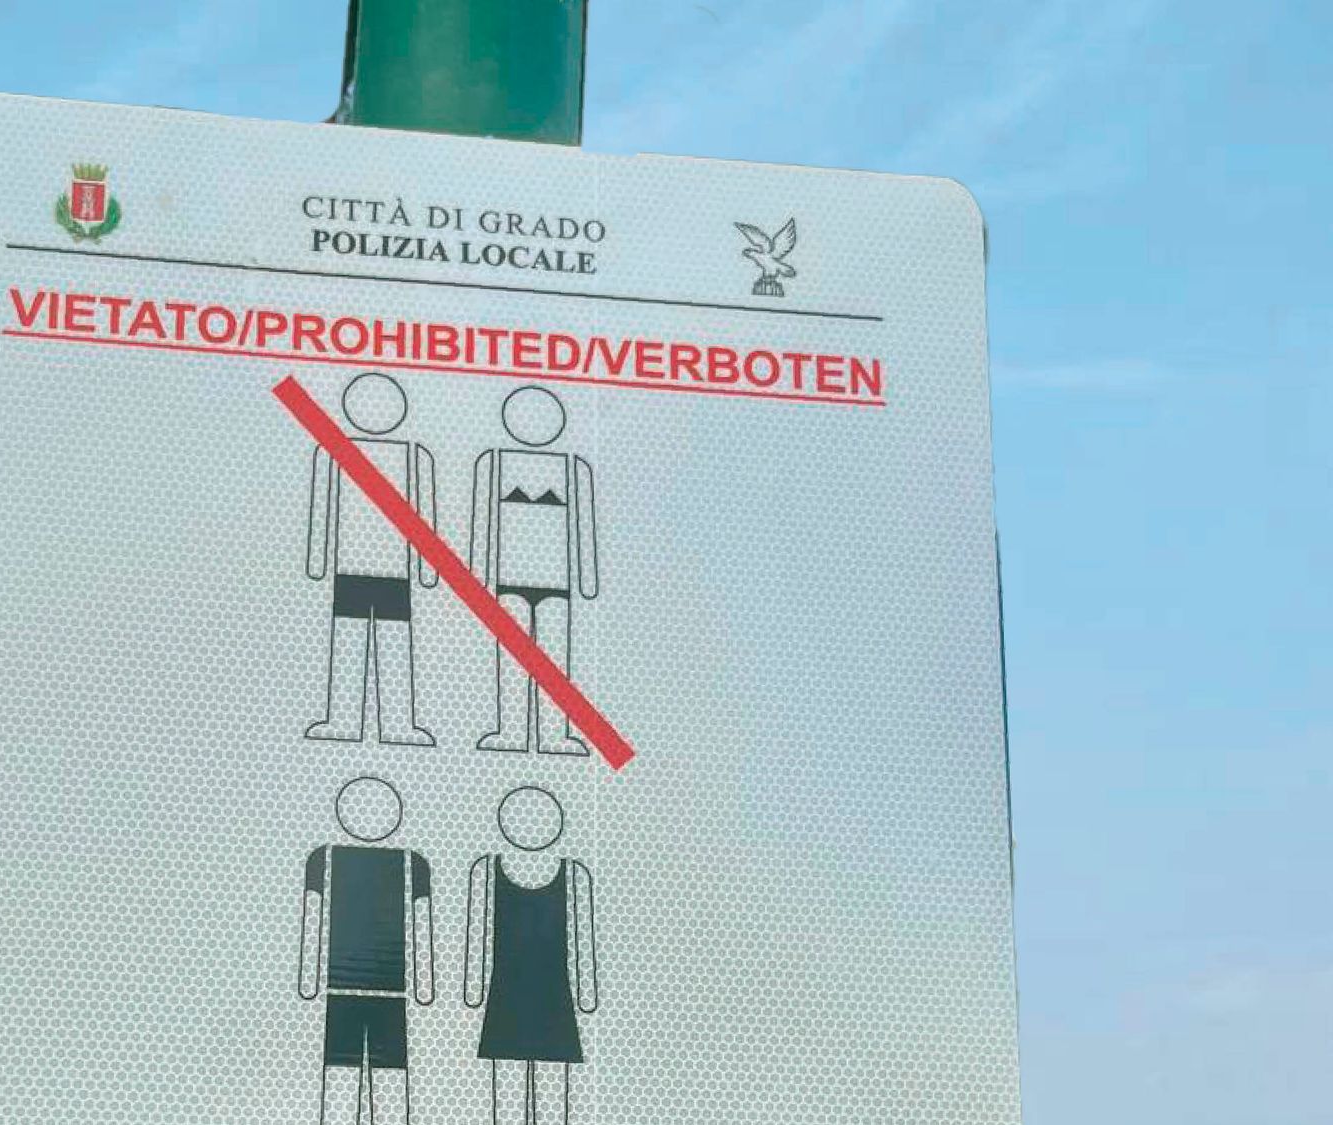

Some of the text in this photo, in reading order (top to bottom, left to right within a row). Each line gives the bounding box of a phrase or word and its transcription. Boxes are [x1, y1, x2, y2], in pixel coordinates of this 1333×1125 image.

[302, 197, 605, 242] CITTÀ DI GRADO
[310, 229, 597, 274] POLIZIA LOCALE
[9, 288, 882, 397] VIETATO/PROHIBITED/VERBOTEN
